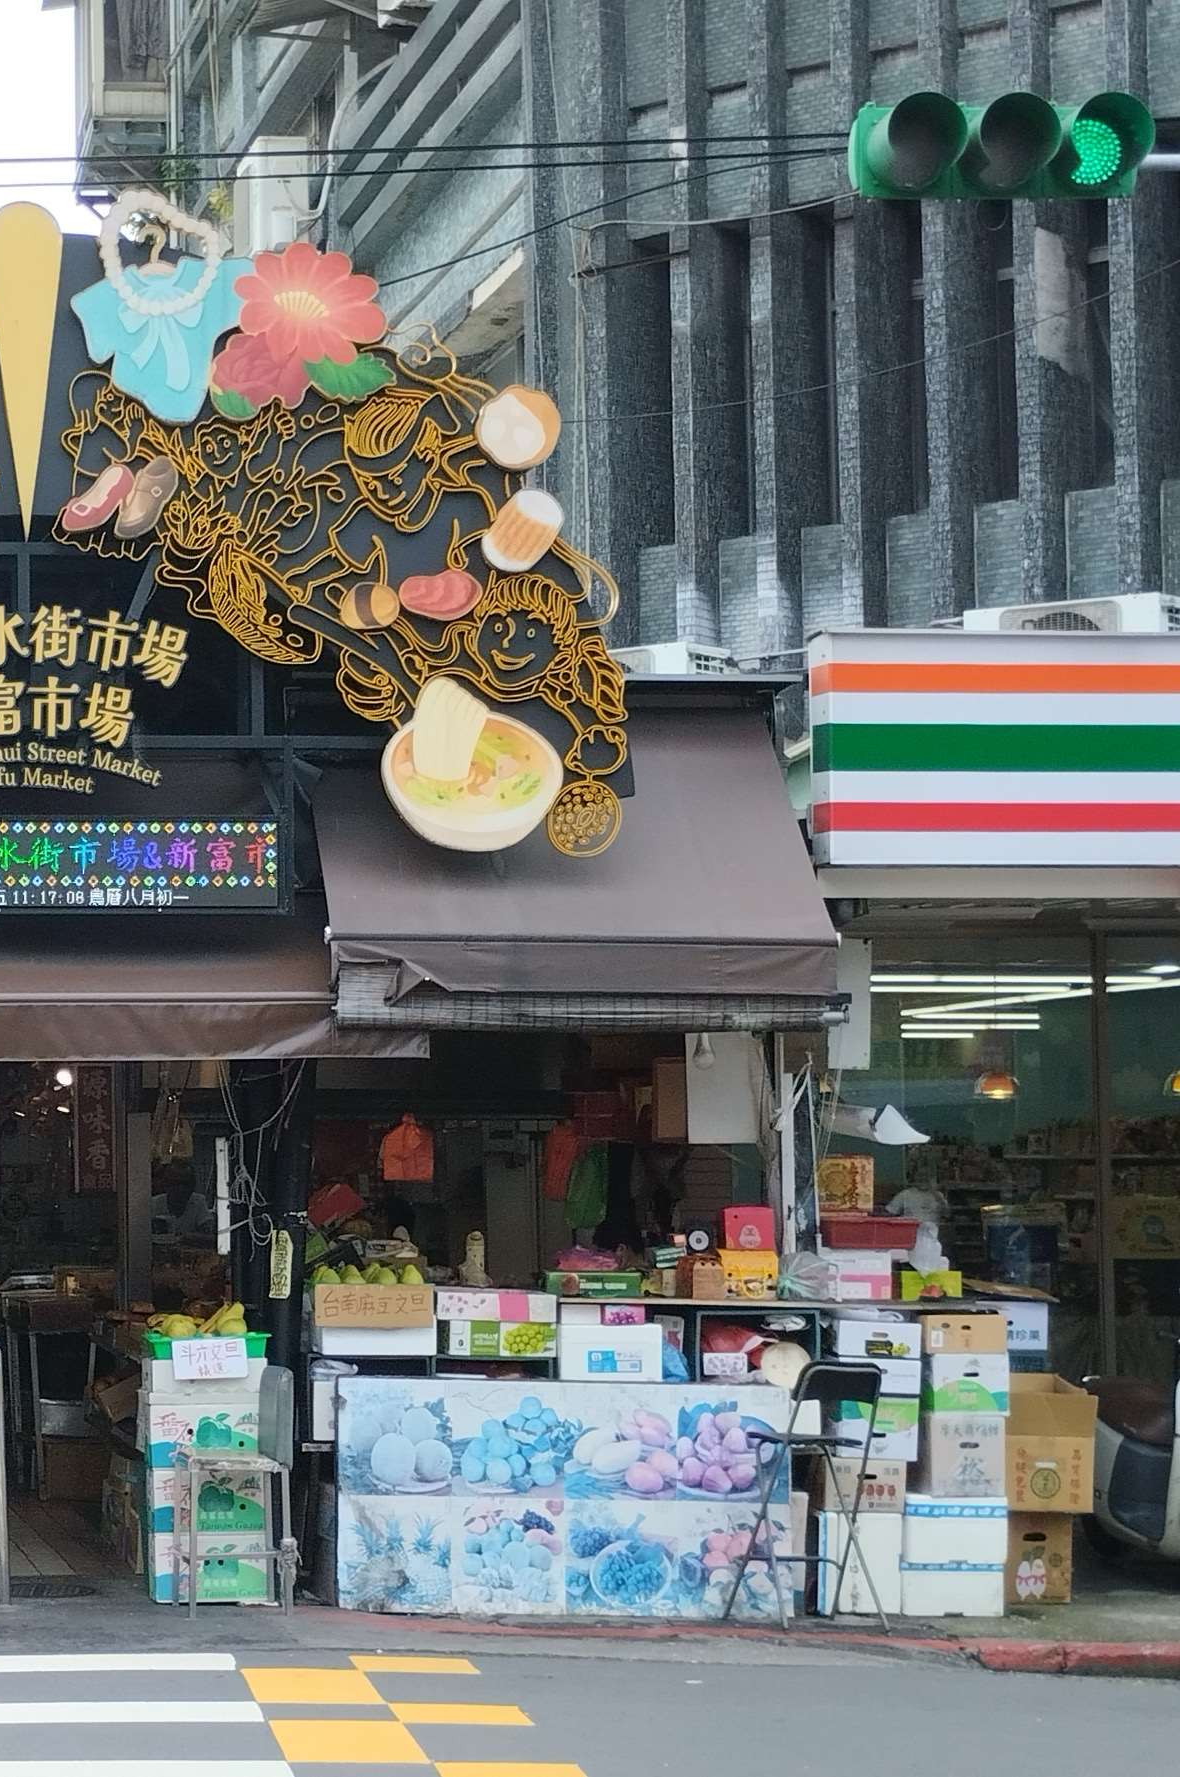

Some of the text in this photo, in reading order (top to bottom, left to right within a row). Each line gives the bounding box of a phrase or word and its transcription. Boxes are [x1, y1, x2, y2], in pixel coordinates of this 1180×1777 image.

[27, 742, 88, 766] Street
[90, 752, 163, 787] Market
[22, 768, 95, 795] Market
[12, 890, 85, 906] 11:17:08
